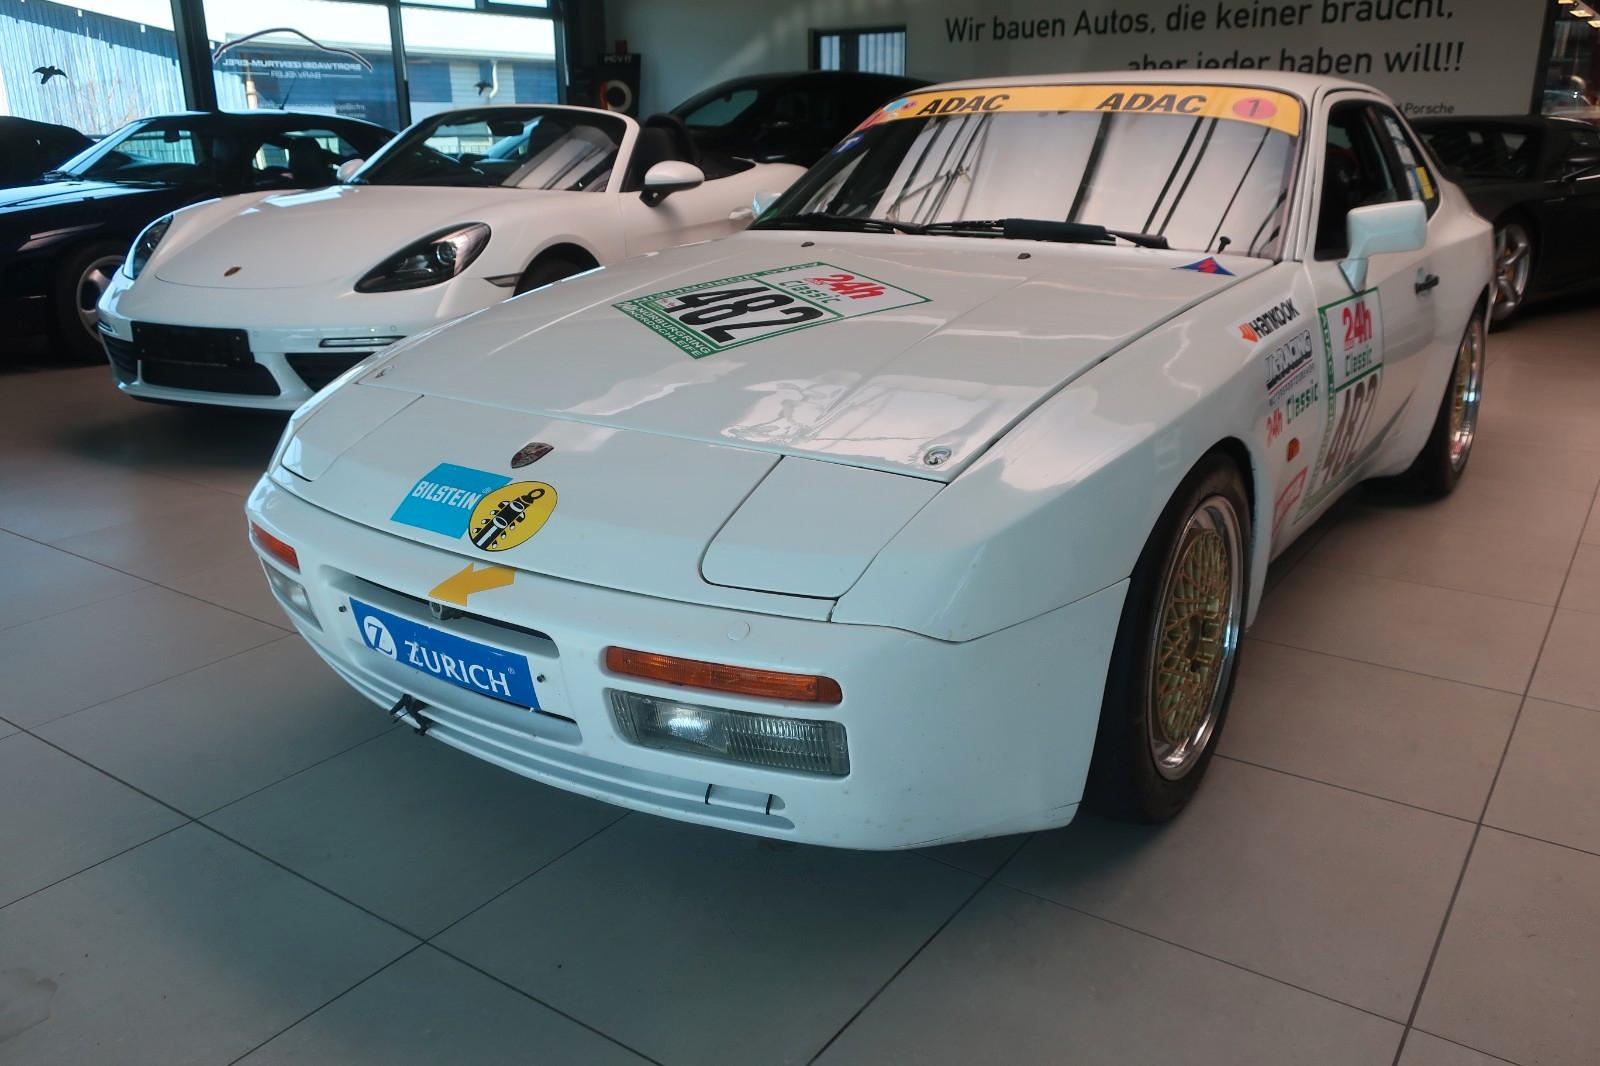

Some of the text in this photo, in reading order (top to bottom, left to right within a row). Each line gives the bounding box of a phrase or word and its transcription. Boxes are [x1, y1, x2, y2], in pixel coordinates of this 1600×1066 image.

[945, 17, 985, 42] Wir
[992, 15, 1065, 41] bauen
[1074, 9, 1156, 36] Autos,
[1166, 4, 1206, 31] die
[1216, 2, 1310, 29] keiner
[1279, 47, 1372, 74] haben
[1384, 42, 1464, 72] will!!
[916, 94, 1010, 116] ADAC
[1095, 92, 1208, 114] ADAC
[1405, 102, 1455, 115] Porsche
[779, 280, 841, 304] Classic
[803, 274, 887, 299] 24h
[664, 286, 824, 343] 482
[1342, 301, 1373, 344] 24h
[1345, 346, 1373, 377] Classic
[411, 480, 481, 511] BILSTEIN
[404, 639, 512, 697] ZURICH
